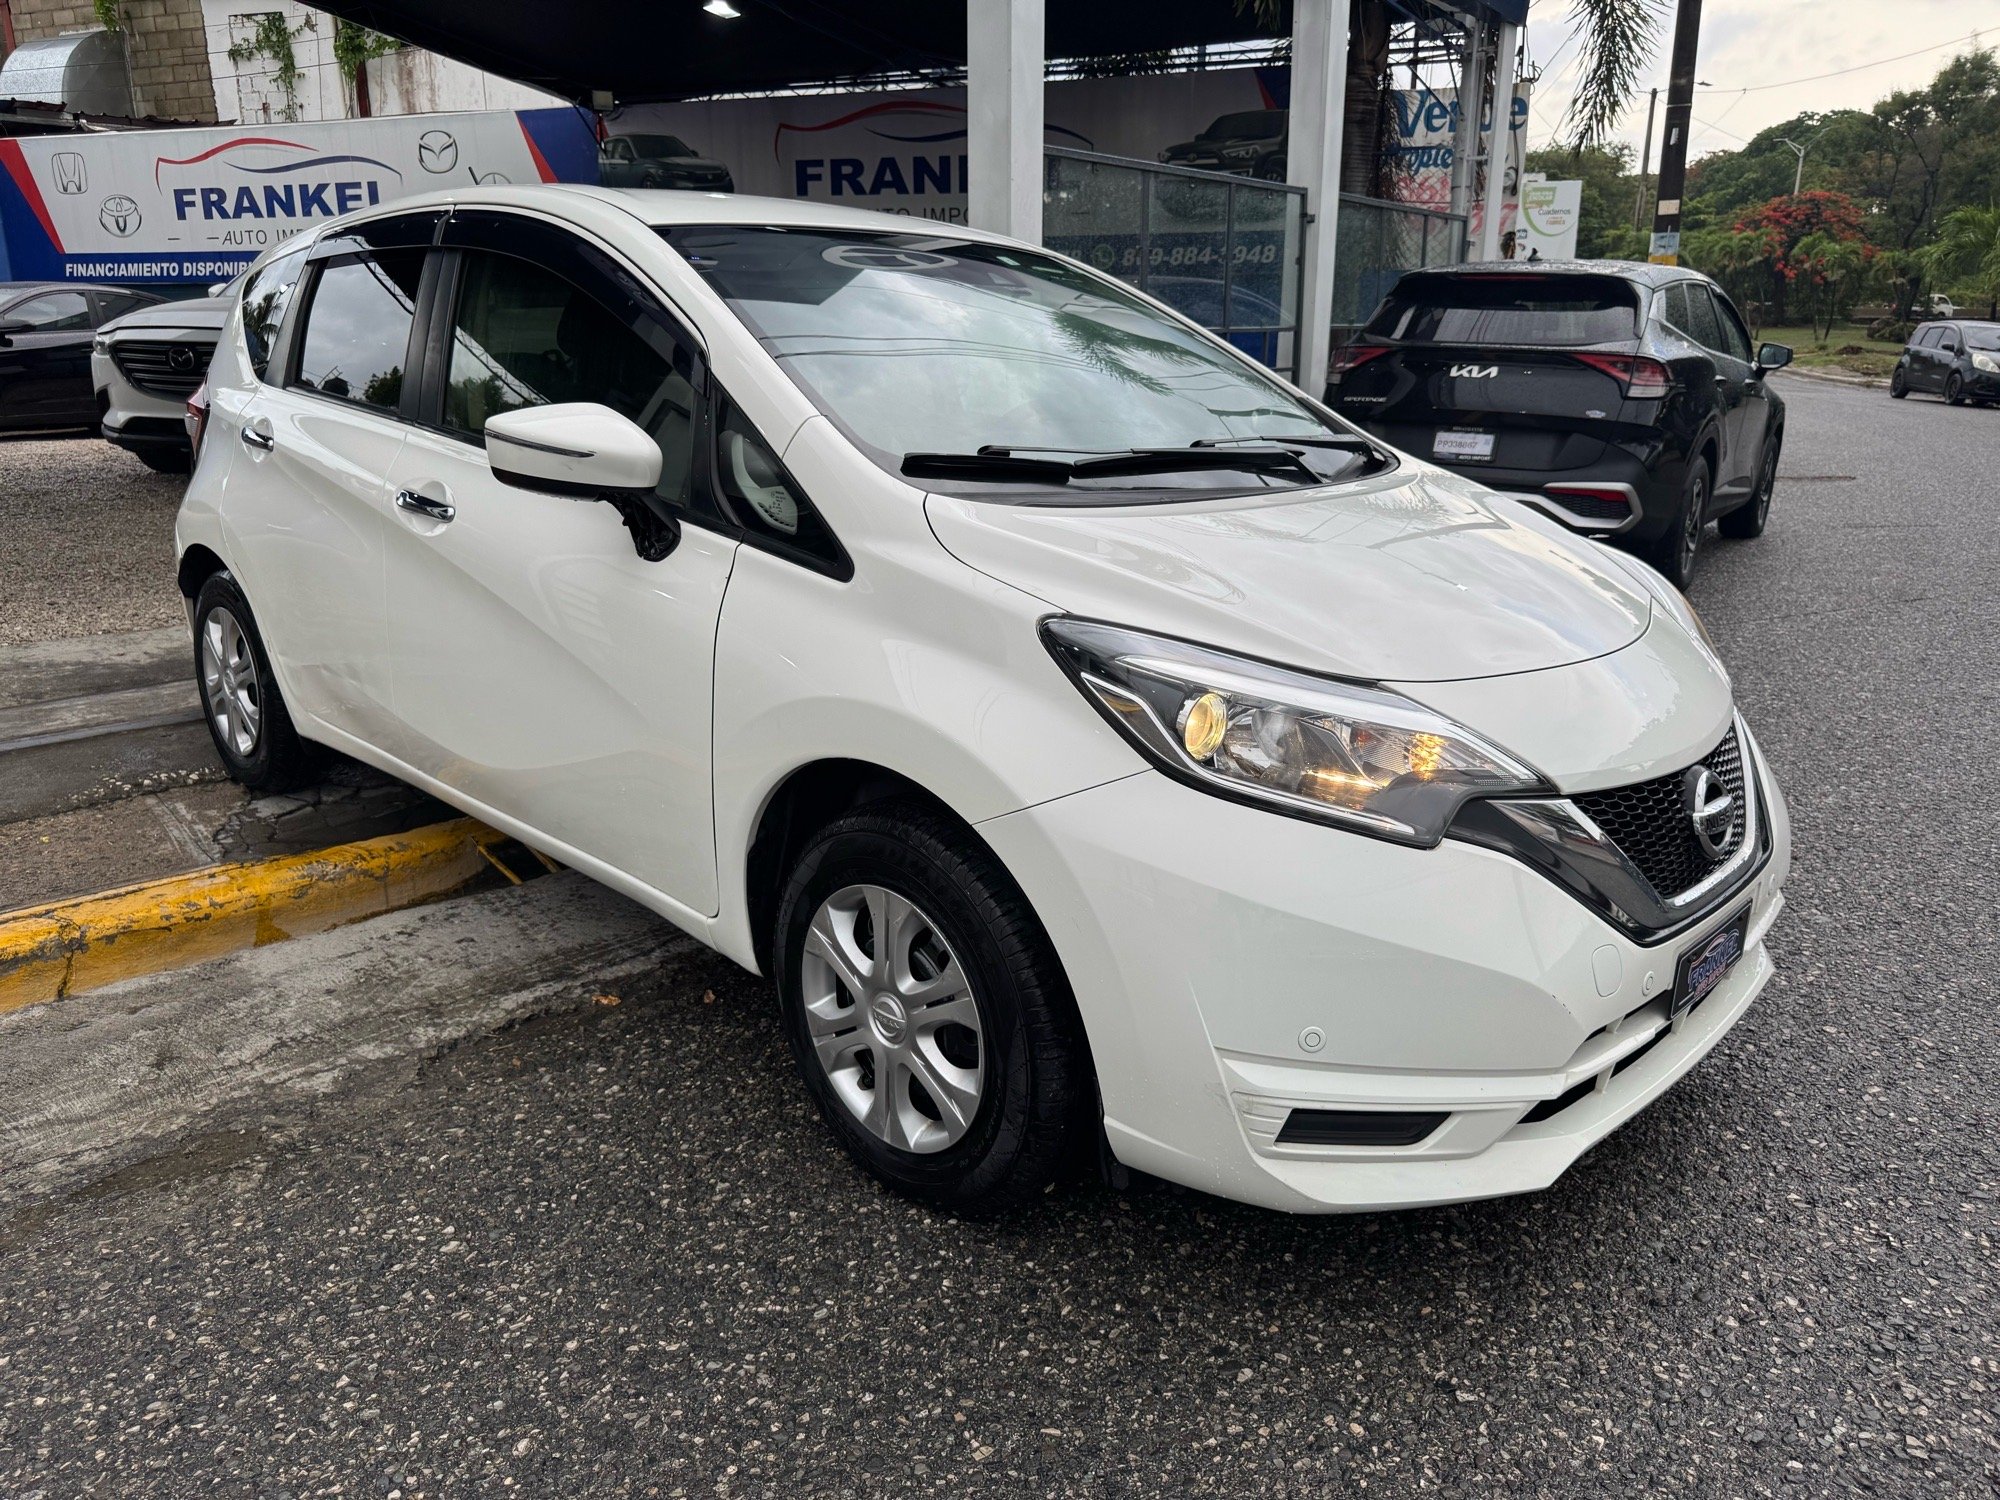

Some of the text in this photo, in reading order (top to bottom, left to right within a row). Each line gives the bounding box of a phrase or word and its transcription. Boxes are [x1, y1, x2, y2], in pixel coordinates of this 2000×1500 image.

[222, 229, 267, 245] AUTO
[1122, 244, 1276, 266] 89-884-948
[65, 262, 179, 277] FINANCIAMIENTO
